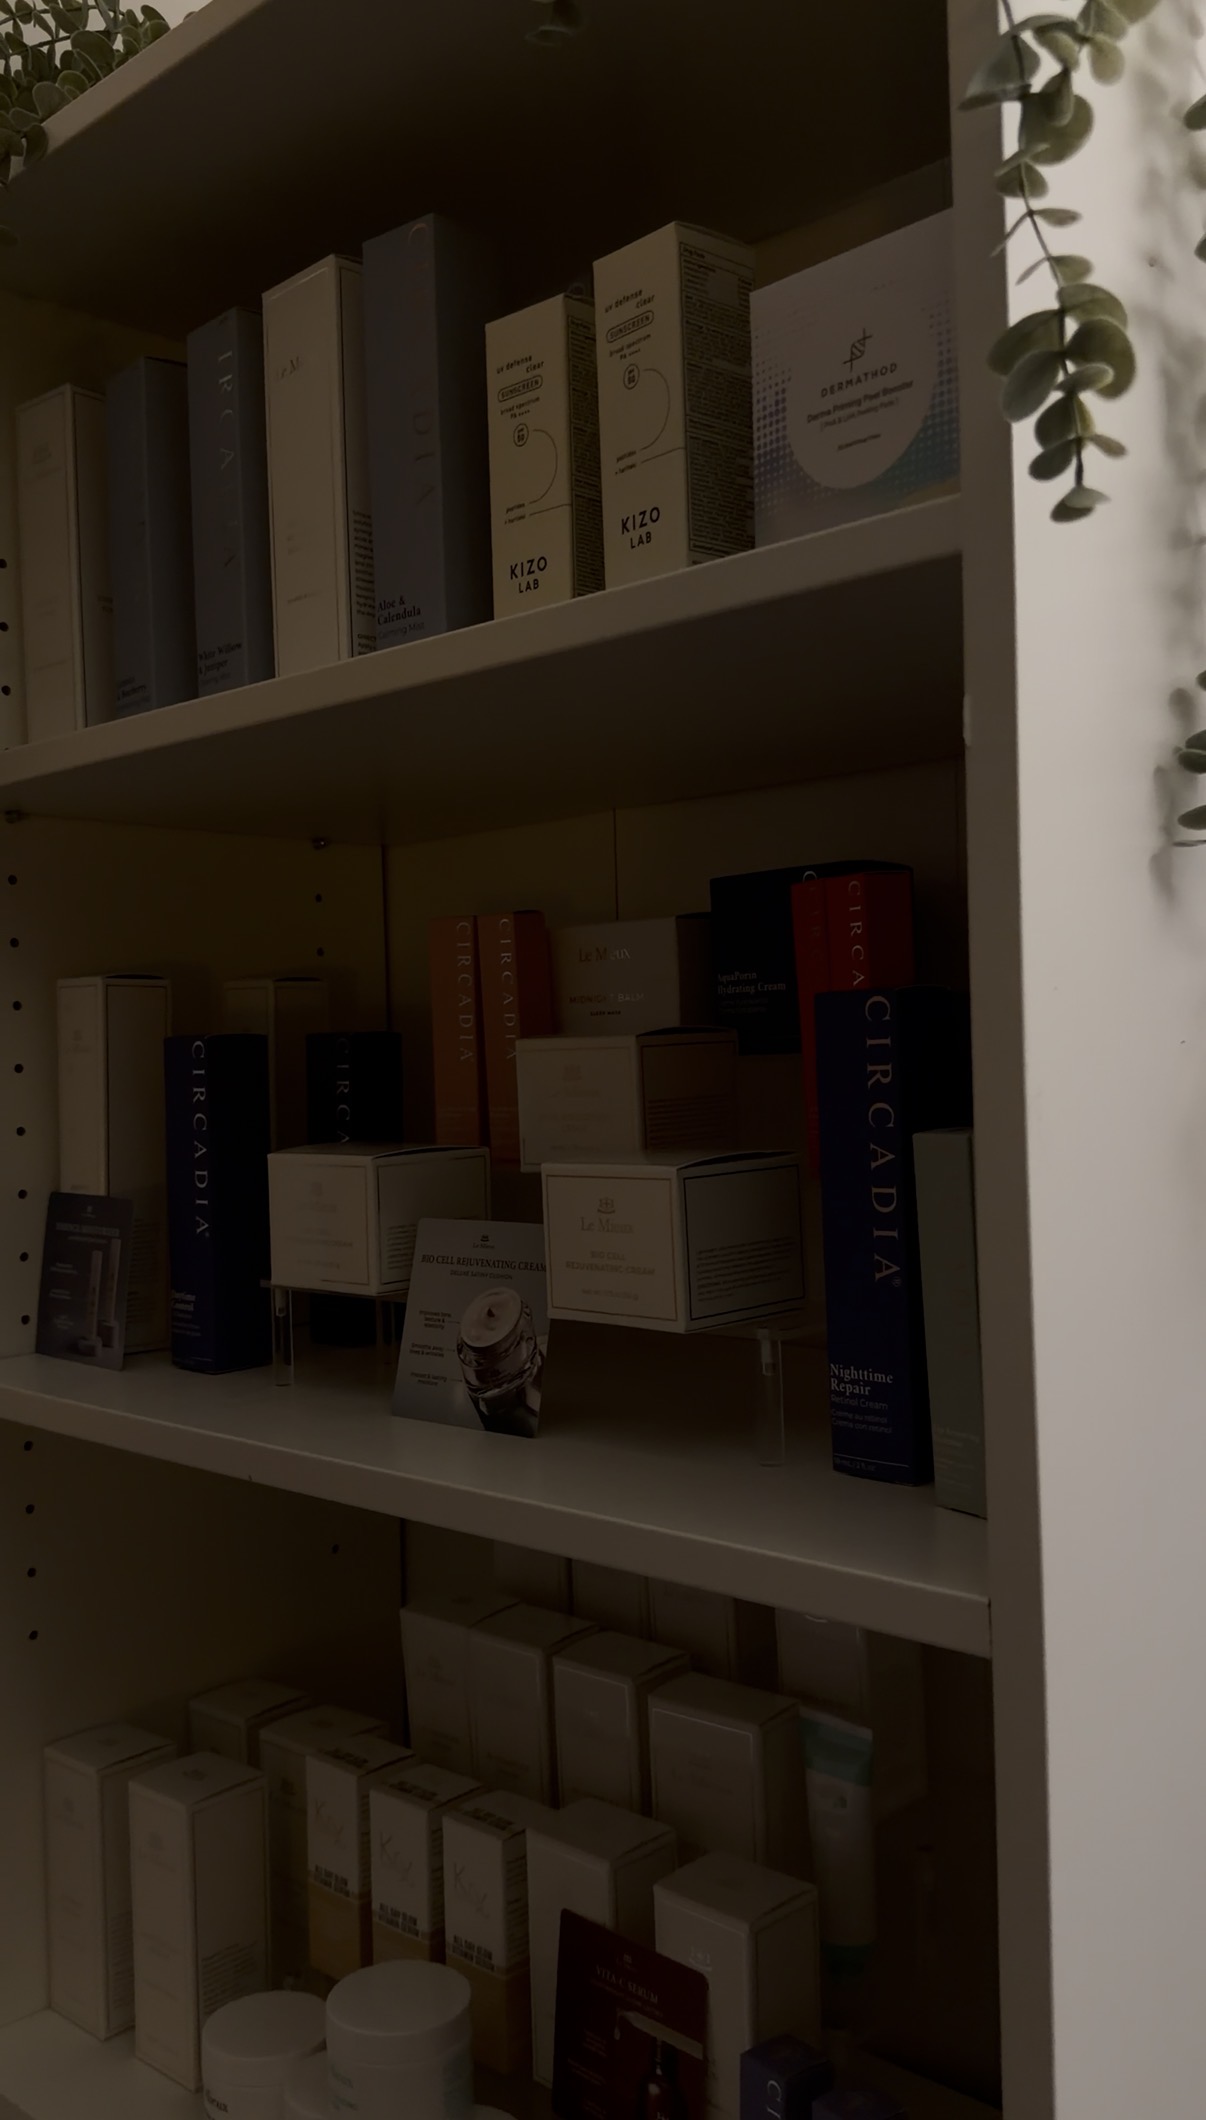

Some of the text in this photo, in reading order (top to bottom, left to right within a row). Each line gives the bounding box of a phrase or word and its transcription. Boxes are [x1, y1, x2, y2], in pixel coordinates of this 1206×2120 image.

[608, 313, 650, 340] SUNSCREEN
[820, 361, 898, 399] DERMATHOD
[621, 506, 661, 536] KIZO
[630, 530, 653, 550] LAB
[510, 556, 548, 580] KIZO
[518, 578, 540, 594] LAB
[377, 598, 397, 613] Aloe
[377, 605, 422, 627] Calendula
[848, 879, 867, 988] CIRCA
[757, 981, 787, 993] Cream
[420, 1253, 547, 1273] BIO CELL REJUVENATING CREAM
[829, 1362, 895, 1385] Nighttime
[829, 1377, 873, 1397] Repair
[859, 1397, 889, 1411] Cream
